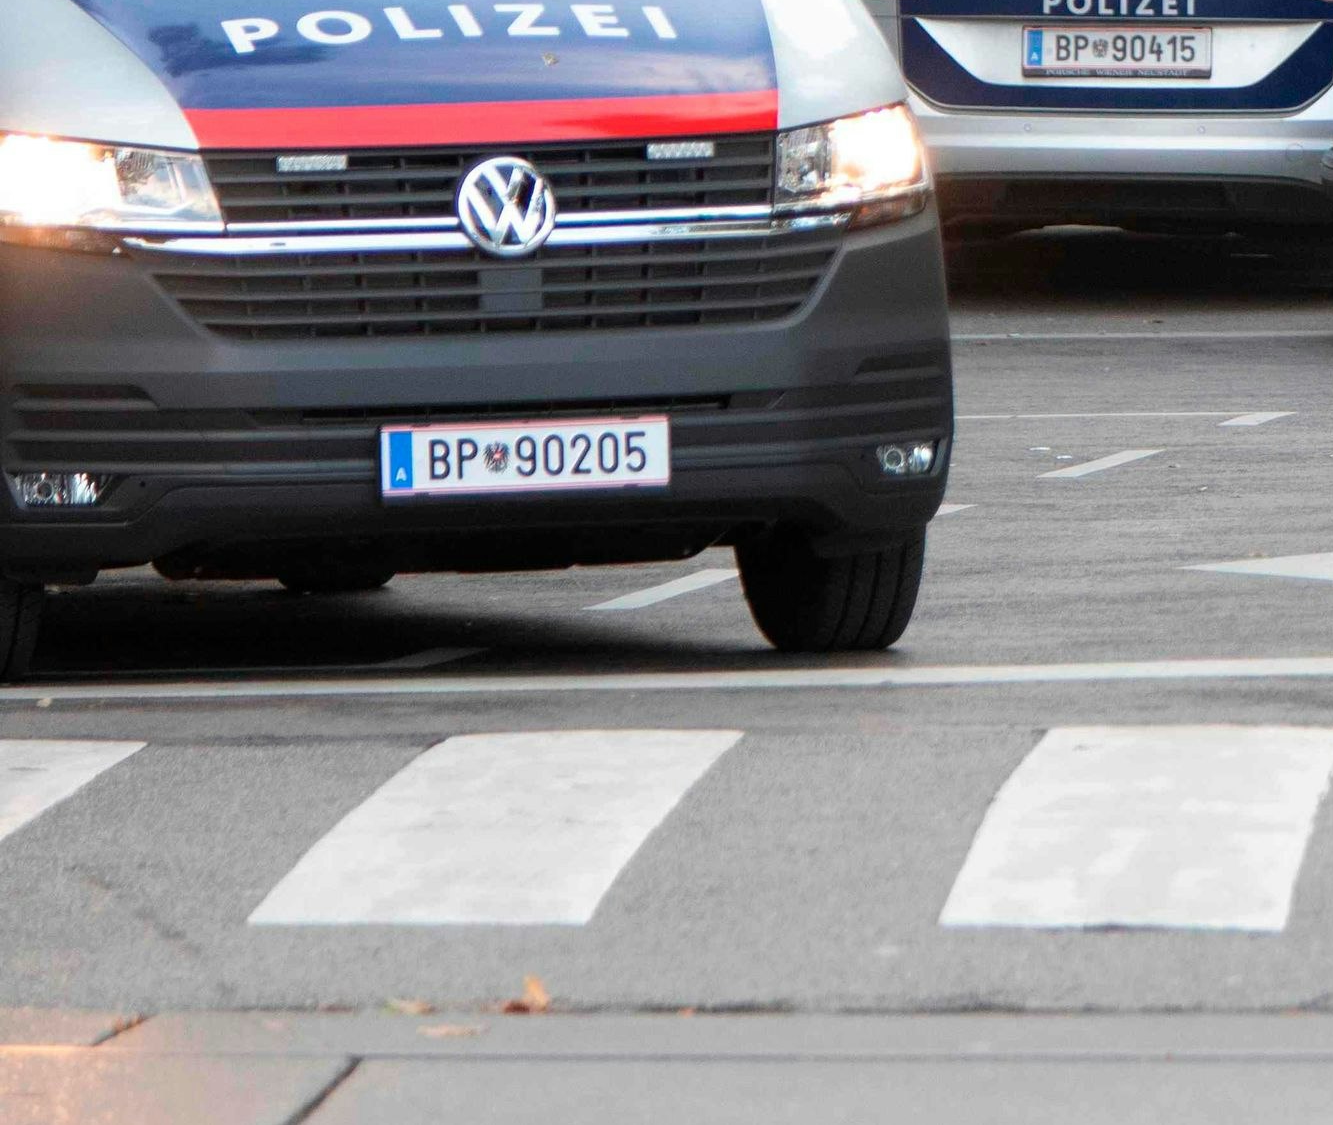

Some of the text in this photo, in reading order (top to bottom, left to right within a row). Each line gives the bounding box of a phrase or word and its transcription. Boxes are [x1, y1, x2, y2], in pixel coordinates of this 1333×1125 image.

[220, 3, 678, 53] POLIZEI
[1056, 34, 1089, 62] BP
[1112, 34, 1196, 63] 90415
[428, 438, 479, 480] BP
[515, 430, 648, 477] 90205
